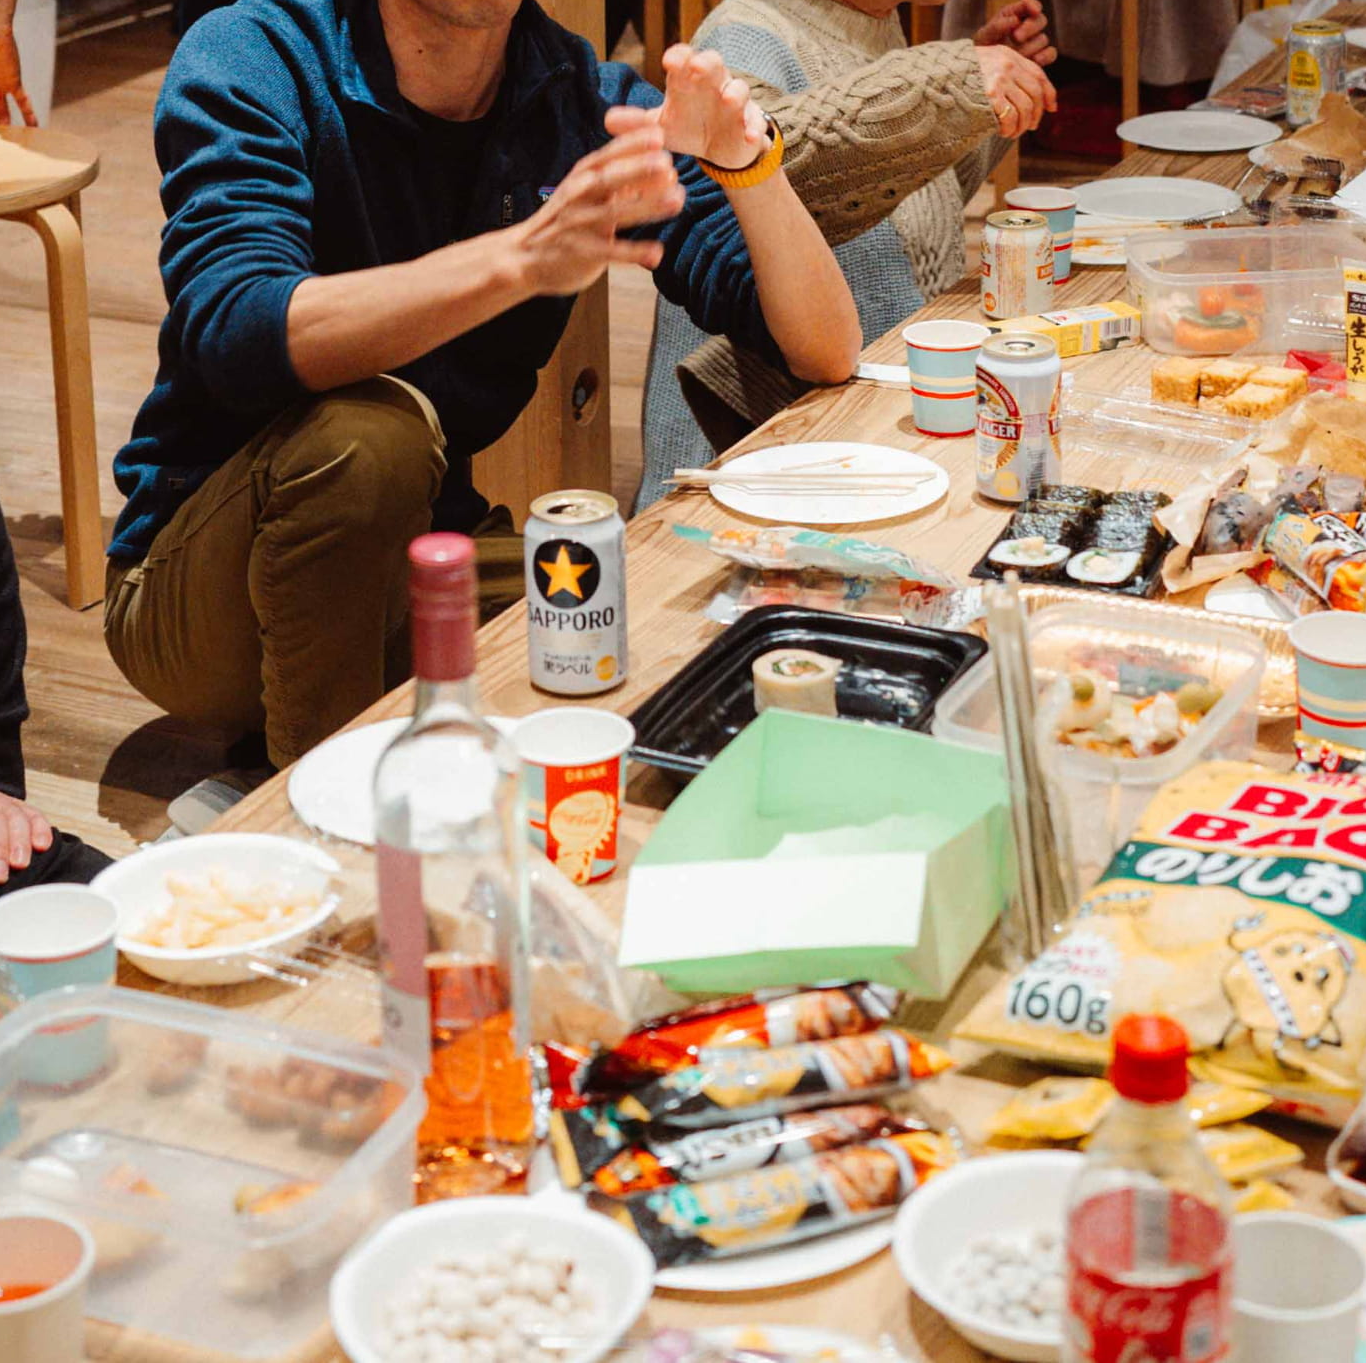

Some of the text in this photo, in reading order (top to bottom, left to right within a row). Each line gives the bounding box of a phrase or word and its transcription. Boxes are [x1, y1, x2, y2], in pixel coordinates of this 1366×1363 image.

[977, 416, 1017, 439] LAGER
[564, 763, 608, 784] DRINK
[1134, 846, 1364, 916] のりしお
[1008, 978, 1108, 1035] 160g
